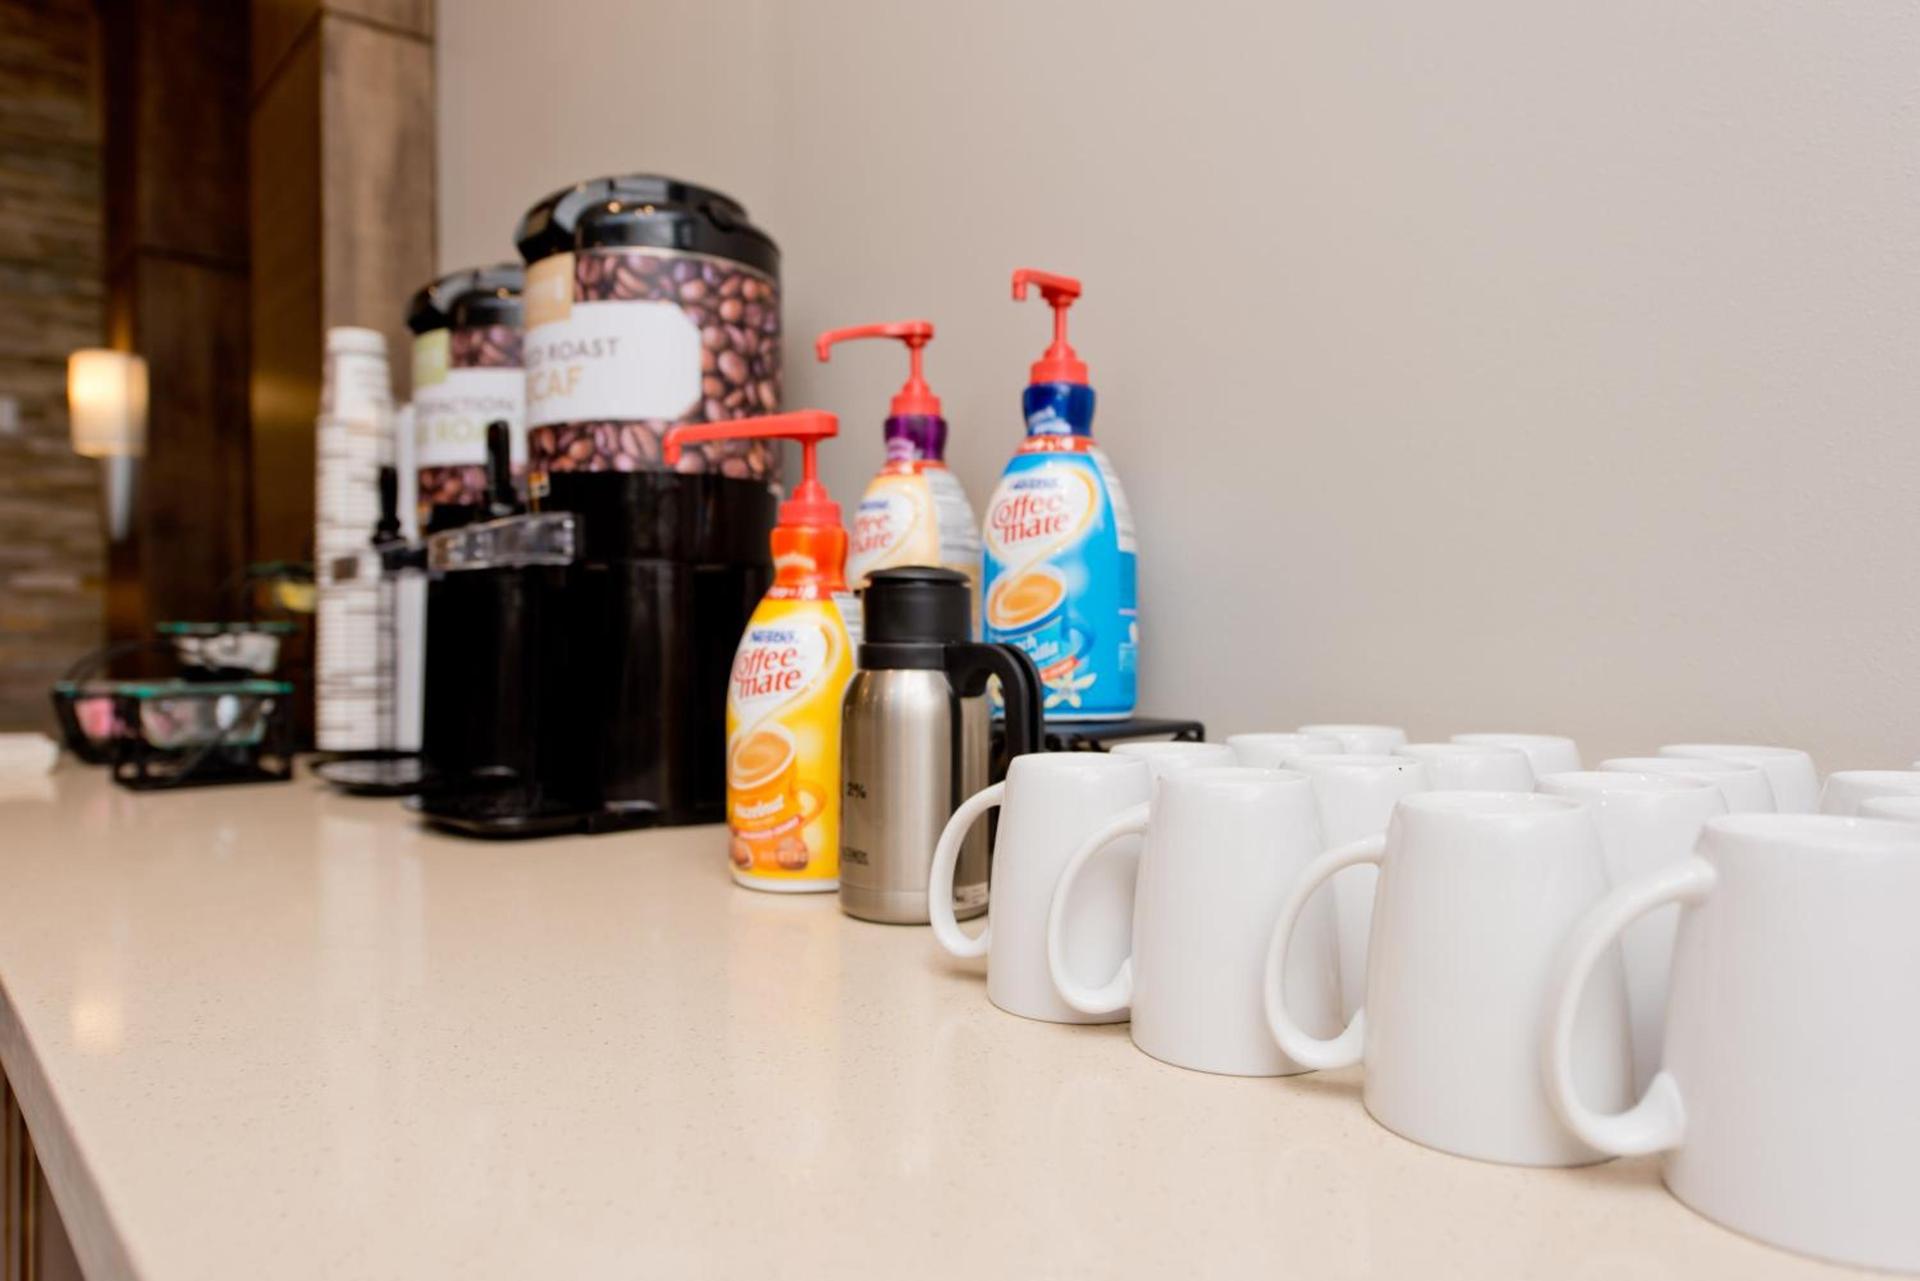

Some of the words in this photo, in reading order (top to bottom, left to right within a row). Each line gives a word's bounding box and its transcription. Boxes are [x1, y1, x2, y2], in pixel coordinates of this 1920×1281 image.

[547, 337, 621, 361] ROAST
[992, 494, 1063, 529] Coffee
[1003, 513, 1069, 543] mate
[739, 669, 801, 699] mate
[847, 782, 867, 799] 2%
